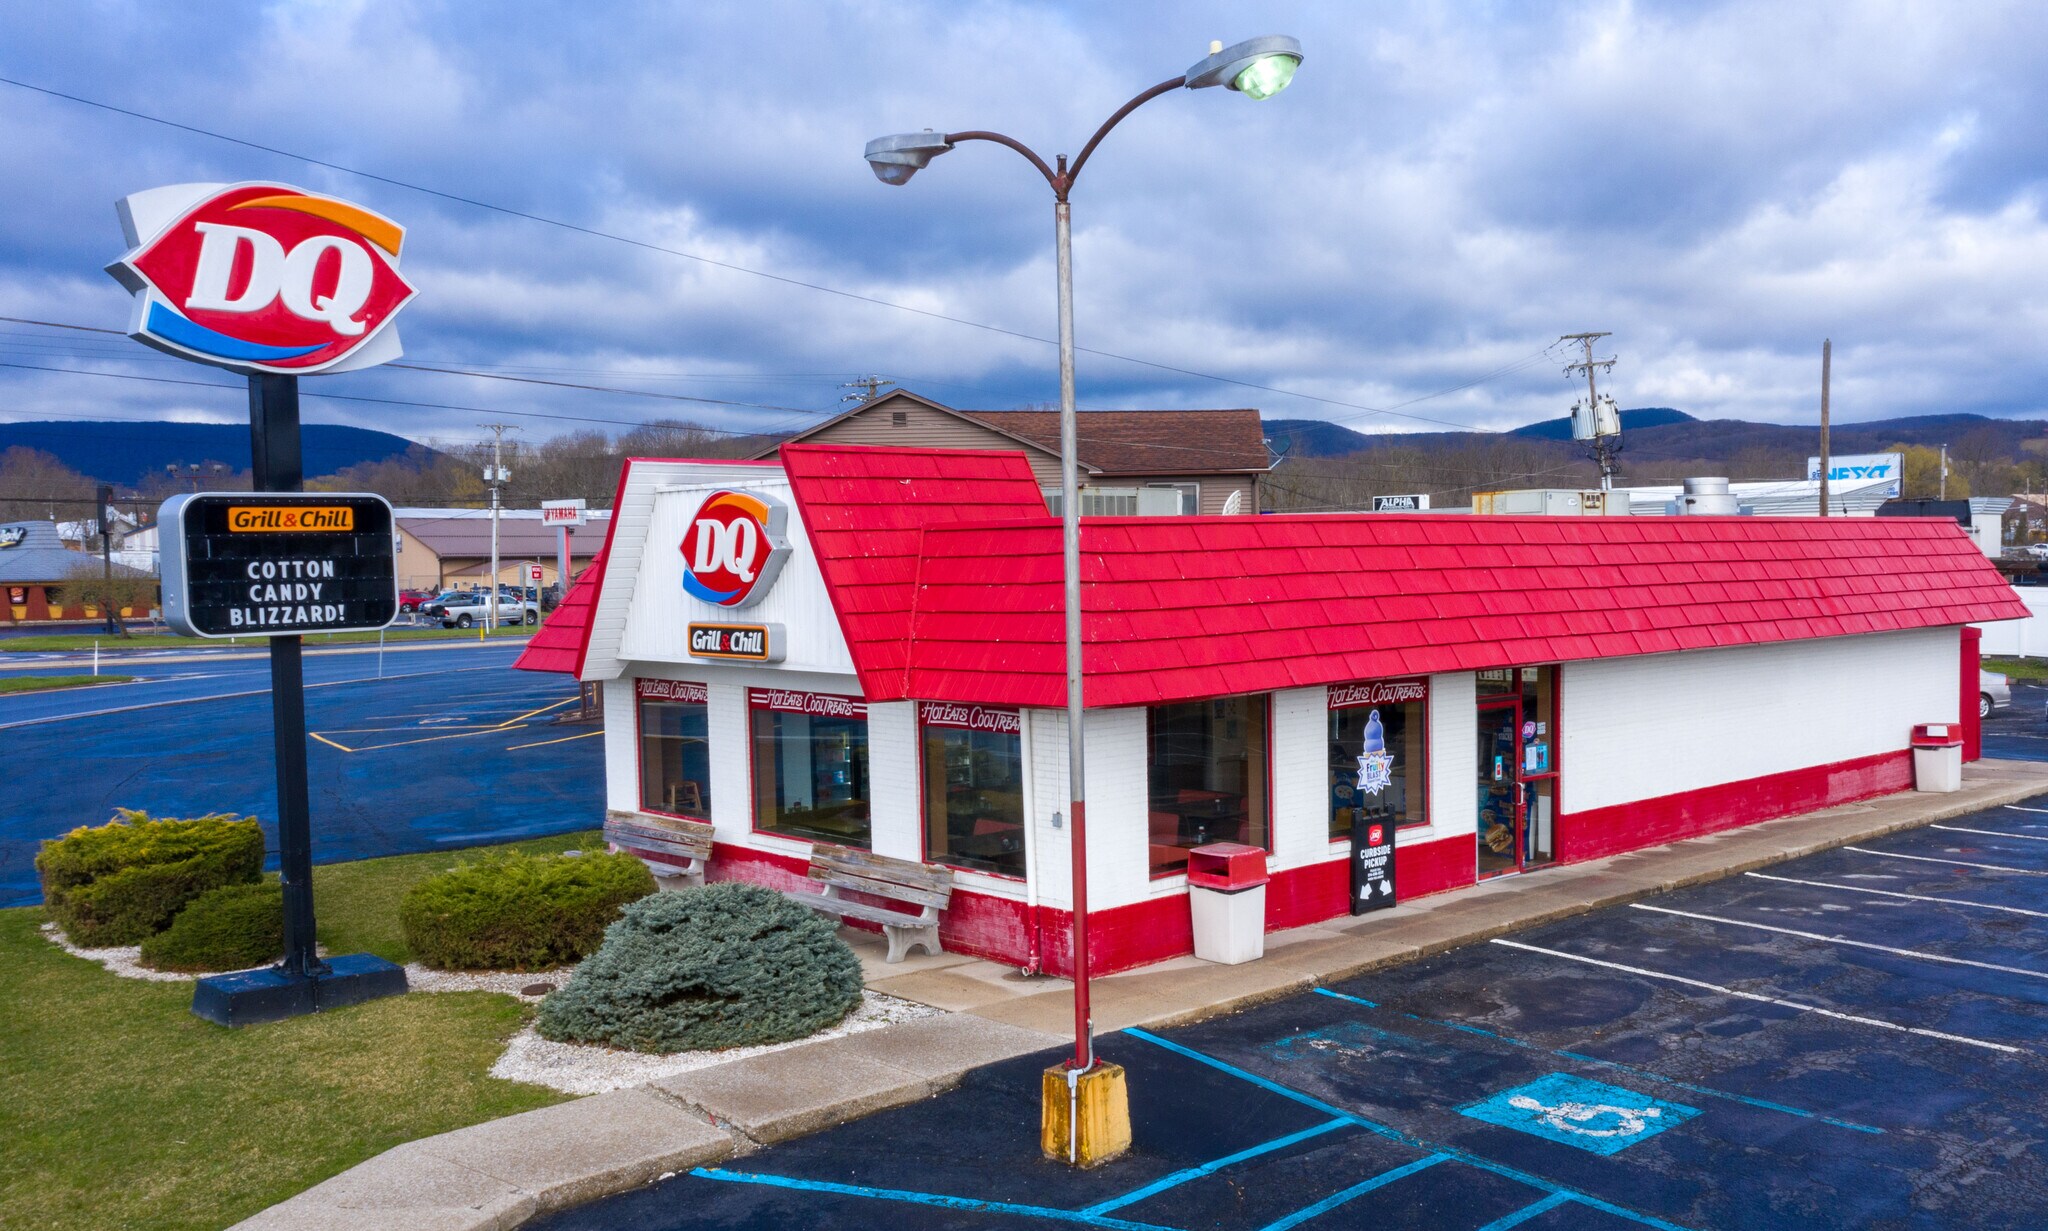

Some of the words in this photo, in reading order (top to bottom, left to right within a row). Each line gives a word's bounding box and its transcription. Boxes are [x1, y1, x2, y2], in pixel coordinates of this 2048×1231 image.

[185, 221, 373, 335] DQ
[1380, 497, 1414, 508] ALPHA
[550, 506, 577, 520] YAMAHA
[693, 517, 757, 583] DQ
[247, 560, 334, 579] COTTON
[250, 583, 322, 602] CANDY
[230, 604, 345, 626] BLIZZARD!
[1360, 844, 1391, 859] CURBSIDE
[1364, 856, 1387, 869] PICKUP
